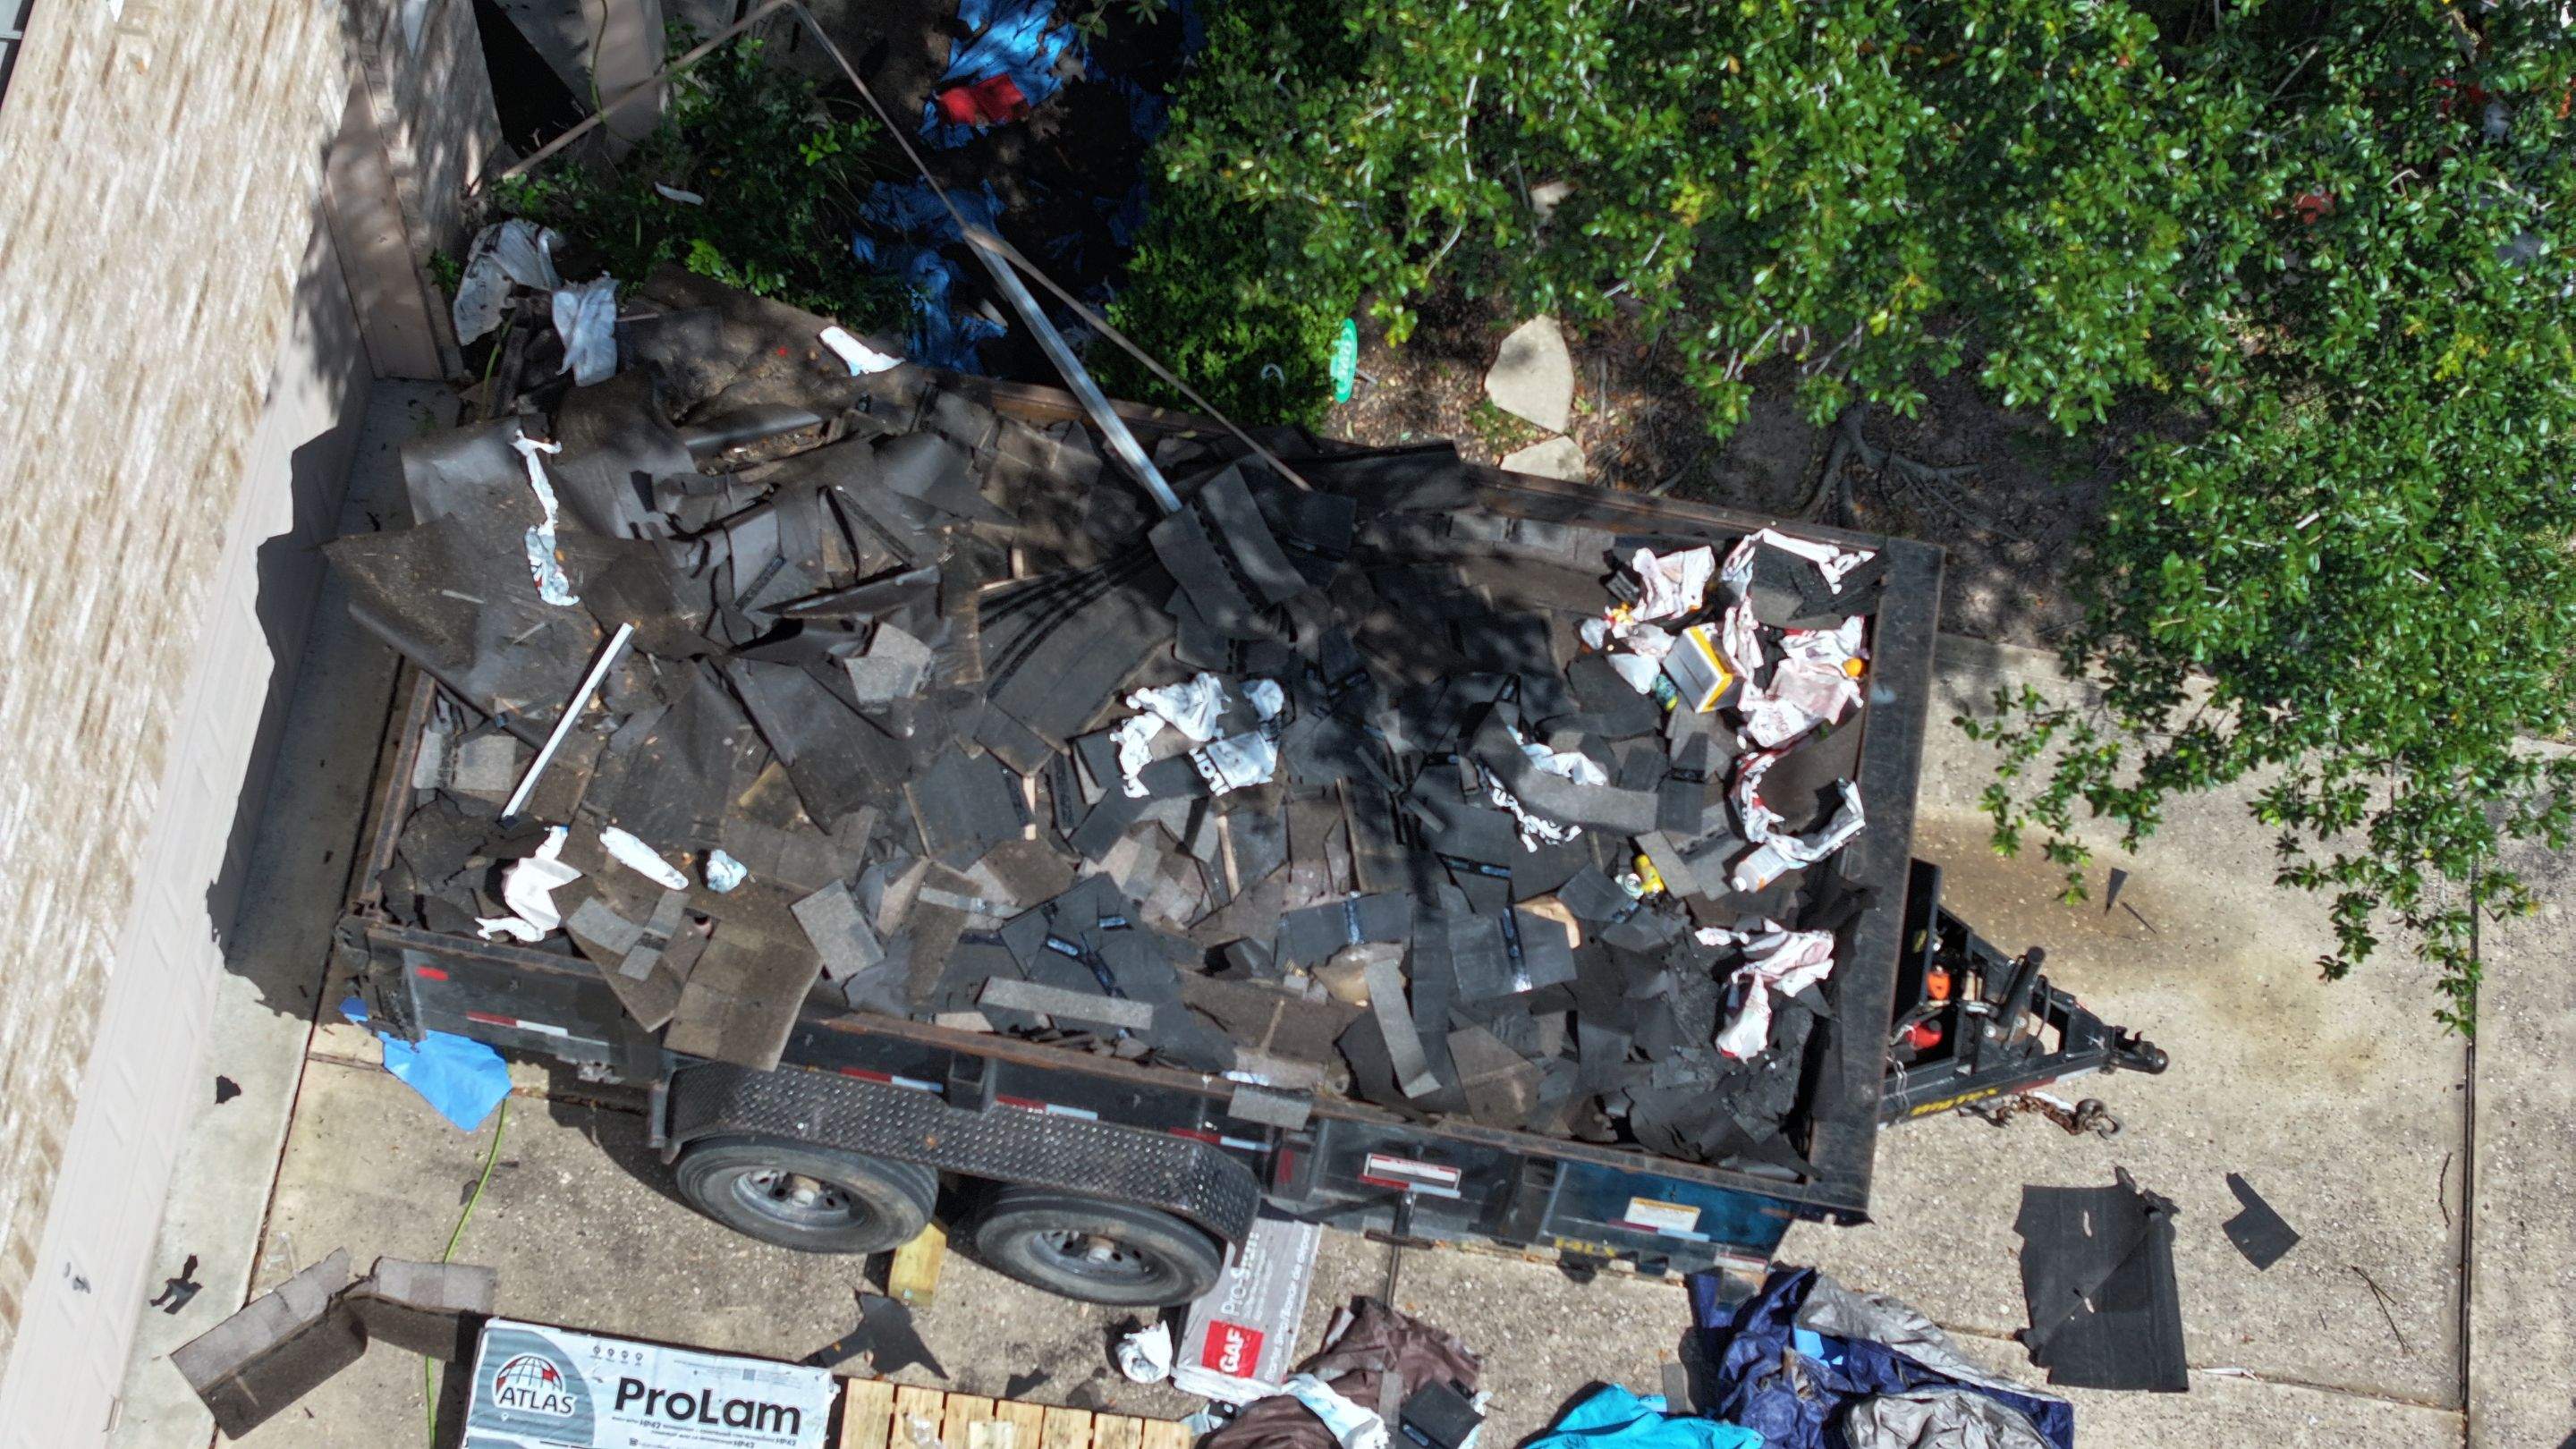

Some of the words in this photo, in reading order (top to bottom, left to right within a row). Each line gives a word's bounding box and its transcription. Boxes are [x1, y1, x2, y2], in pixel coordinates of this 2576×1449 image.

[1218, 1327, 1245, 1373] GAF
[499, 1386, 572, 1414] ATLAS
[614, 1377, 802, 1436] ProLam
